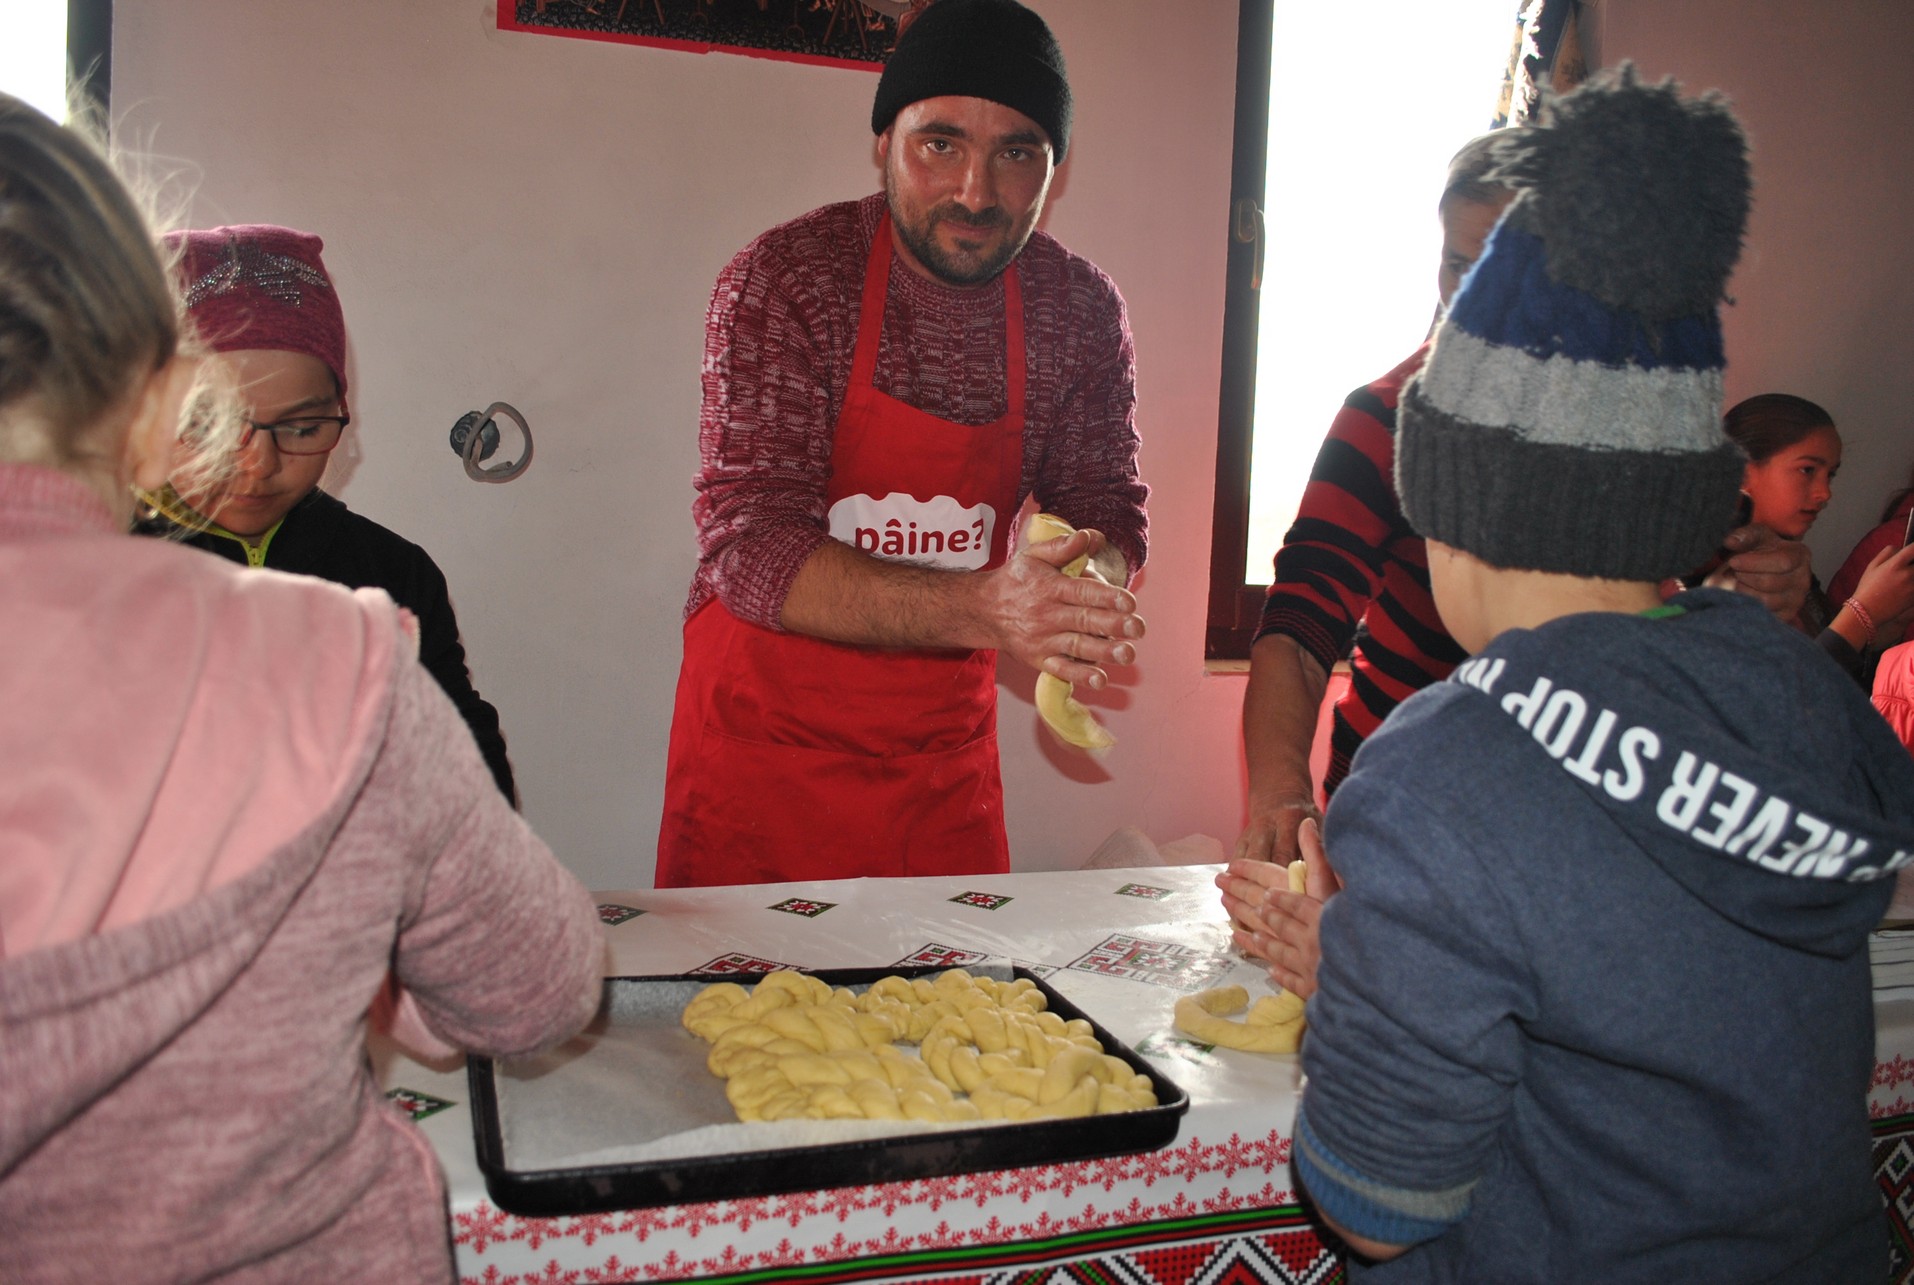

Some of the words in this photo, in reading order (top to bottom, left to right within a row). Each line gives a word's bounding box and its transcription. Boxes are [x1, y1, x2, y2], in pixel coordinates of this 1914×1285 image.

[855, 518, 984, 555] pâine?
[1501, 676, 1660, 801] STOP
[1656, 750, 1869, 879] NEVER
